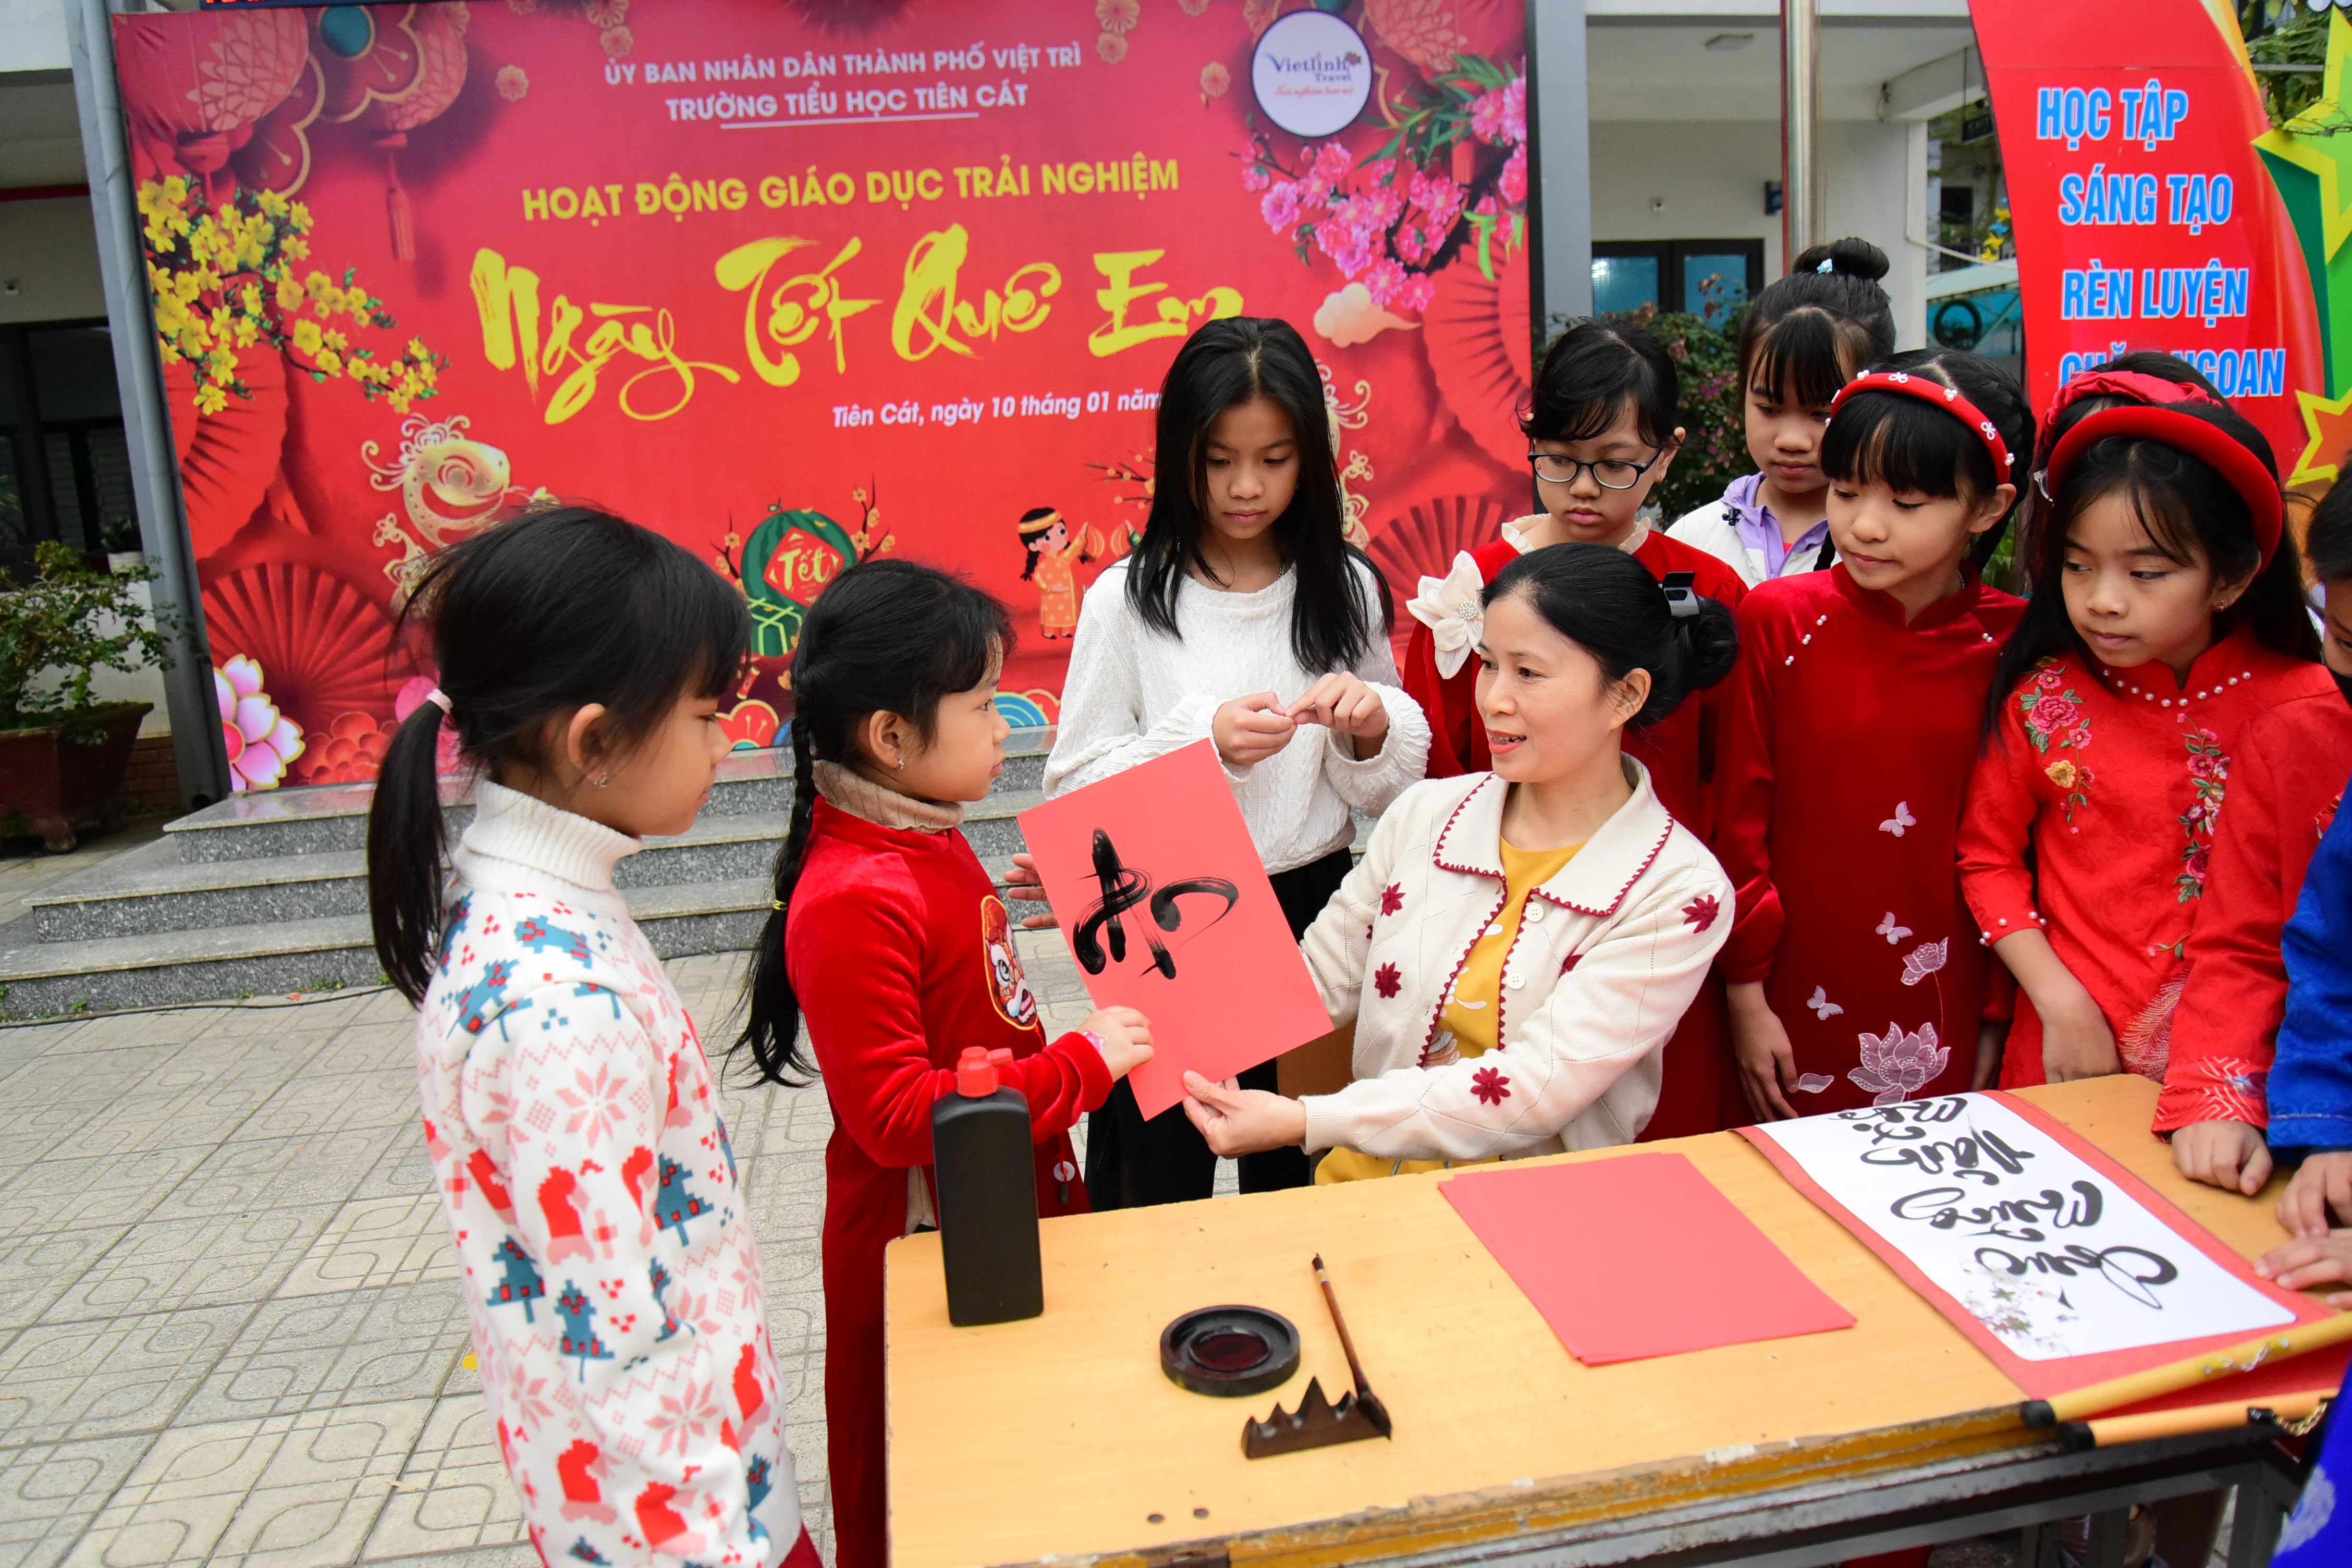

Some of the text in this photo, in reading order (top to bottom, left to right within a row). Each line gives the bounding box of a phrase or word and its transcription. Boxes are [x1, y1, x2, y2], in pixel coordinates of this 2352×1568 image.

[605, 40, 1081, 85] ỦY BAN NHÂN DÂN THÀNH PHỐ VIỆT TRÌ
[666, 78, 1028, 120] TRƯỜNG TIỂU HỌC TIÊN CÁT
[2037, 78, 2188, 151] HỌC TẬP
[523, 151, 1179, 226] HOẠT ĐỘNG GIÁO DỤC TRẢI NGHIỆM
[2059, 163, 2233, 236] SÁNG TẠO
[715, 236, 884, 387] Tết
[891, 225, 1061, 360] Quê
[1088, 248, 1243, 357] Em
[2061, 258, 2249, 328] RÈN LUYỆN
[832, 388, 1160, 427] Tiên Cát, ngày 10 tháng 01 năm
[777, 546, 831, 591] Tết
[1974, 1244, 2178, 1310] Chúc
